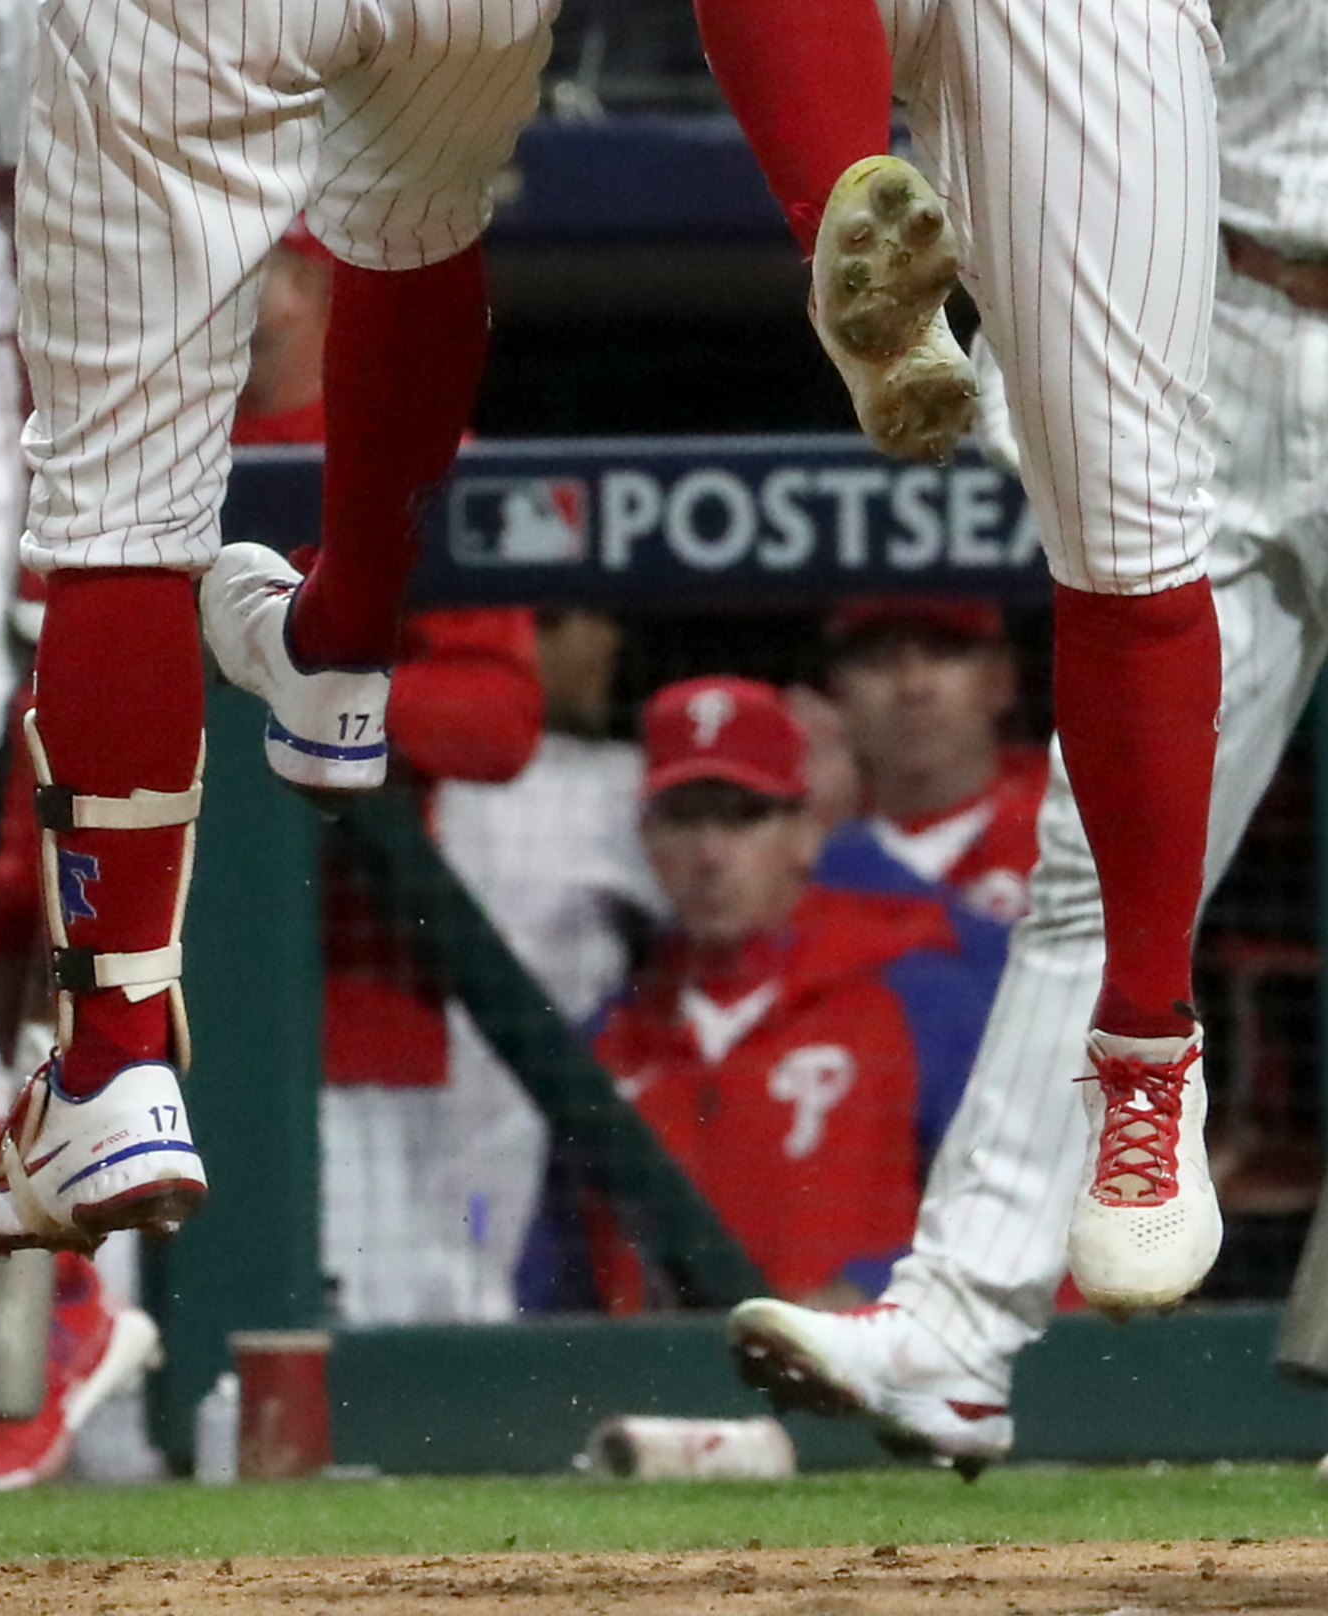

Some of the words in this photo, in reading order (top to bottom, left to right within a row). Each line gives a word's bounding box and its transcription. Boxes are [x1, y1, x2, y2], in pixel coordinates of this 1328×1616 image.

[338, 711, 371, 741] 17
[687, 689, 735, 749] P
[148, 1104, 178, 1133] 17
[769, 1043, 857, 1160] P
